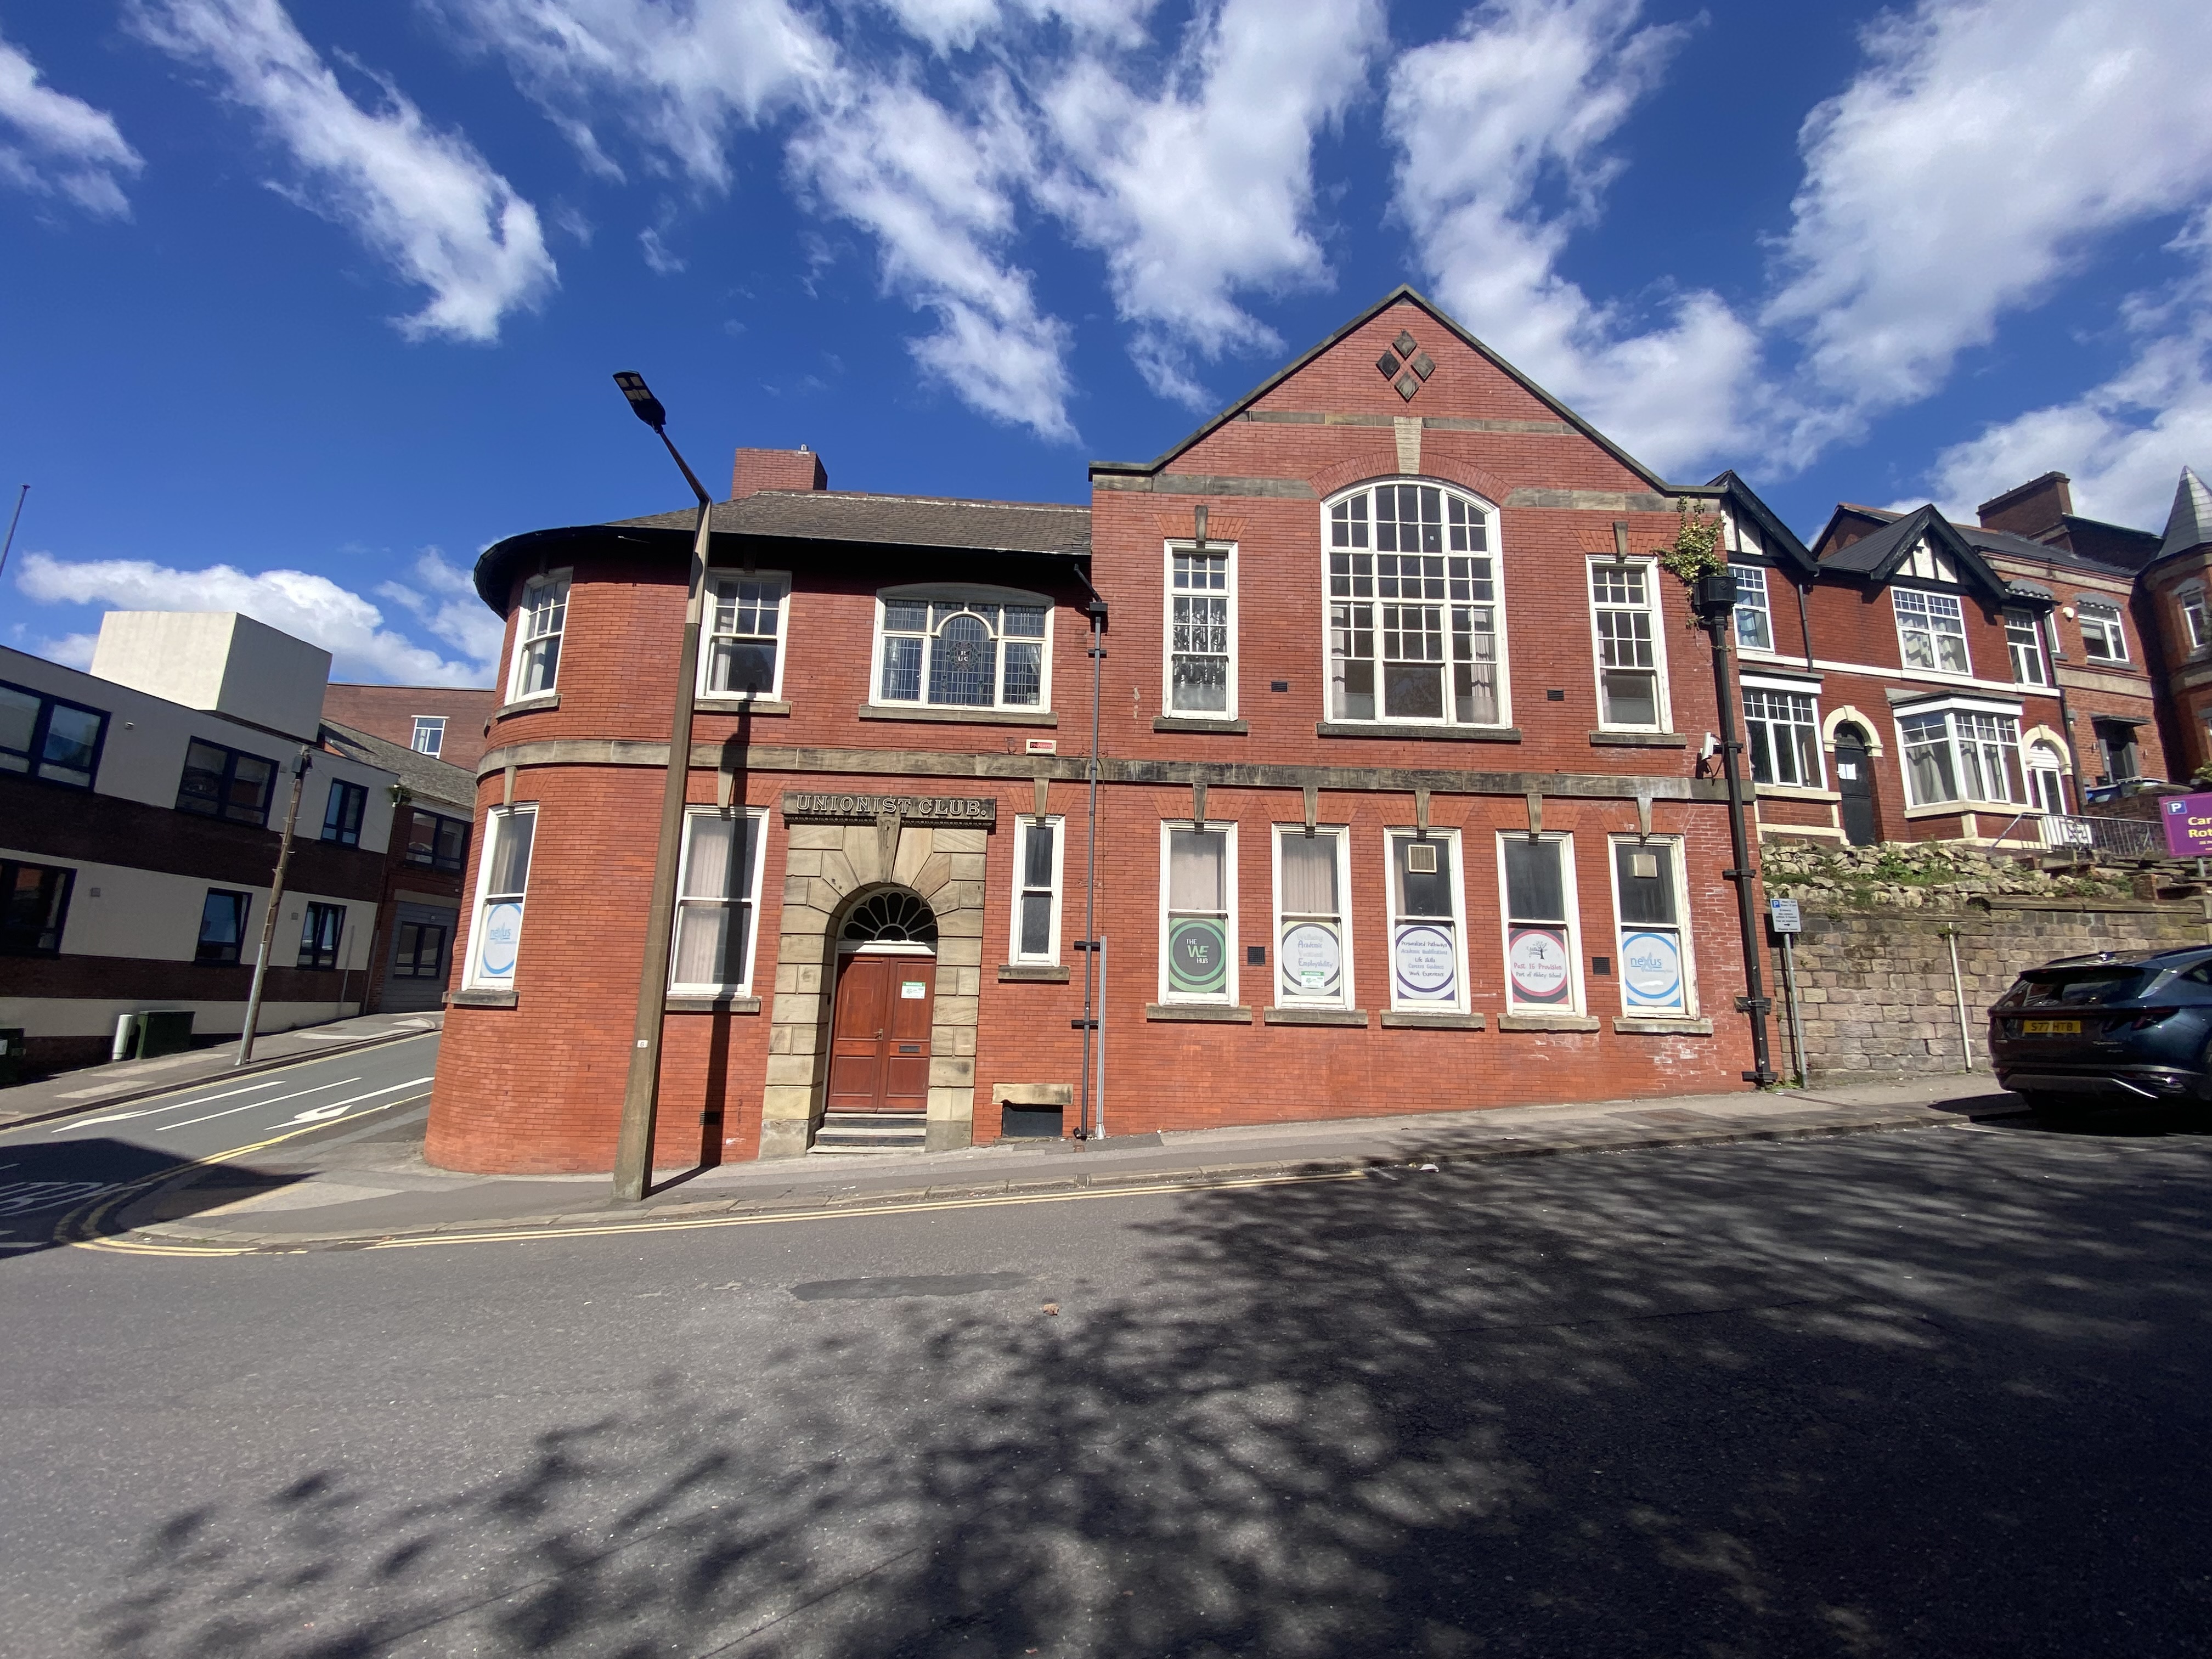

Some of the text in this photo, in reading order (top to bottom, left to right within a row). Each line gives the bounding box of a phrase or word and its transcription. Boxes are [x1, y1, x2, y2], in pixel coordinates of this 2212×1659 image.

[796, 795, 987, 816] UNIONIST CLUB.
[2171, 803, 2182, 812] P
[2187, 816, 2212, 826] Car
[1187, 945, 1209, 957] WE
[1299, 958, 1333, 968] Employability
